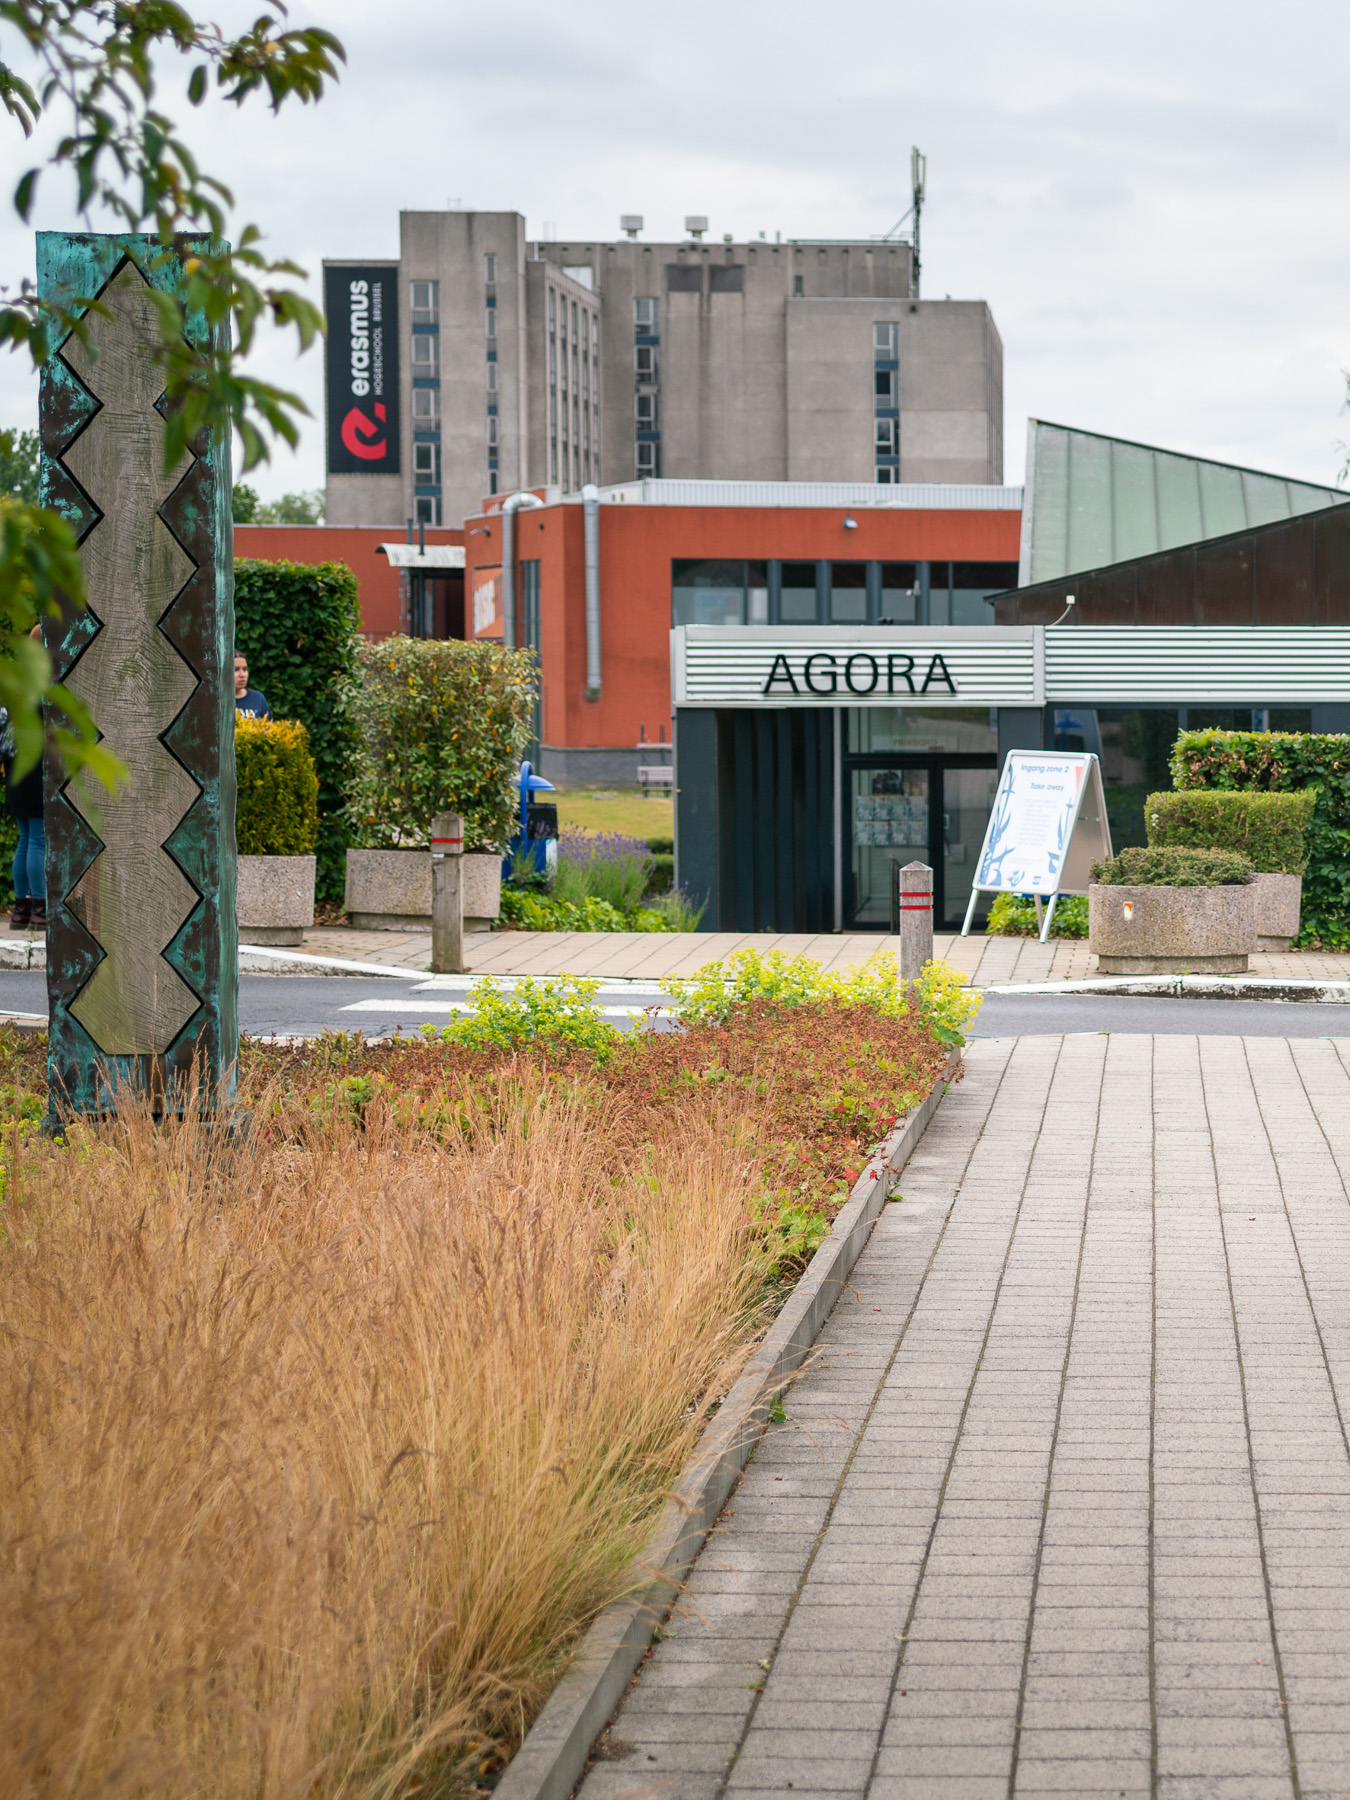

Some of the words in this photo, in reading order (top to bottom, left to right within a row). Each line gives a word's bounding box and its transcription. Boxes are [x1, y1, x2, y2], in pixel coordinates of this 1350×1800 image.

[372, 281, 382, 321] BRUSSEL
[350, 279, 370, 397] erasmus
[373, 327, 383, 395] HOGESCHOOL
[763, 653, 957, 694] AGORA
[1021, 764, 1045, 774] Ingang
[1047, 784, 1064, 792] away
